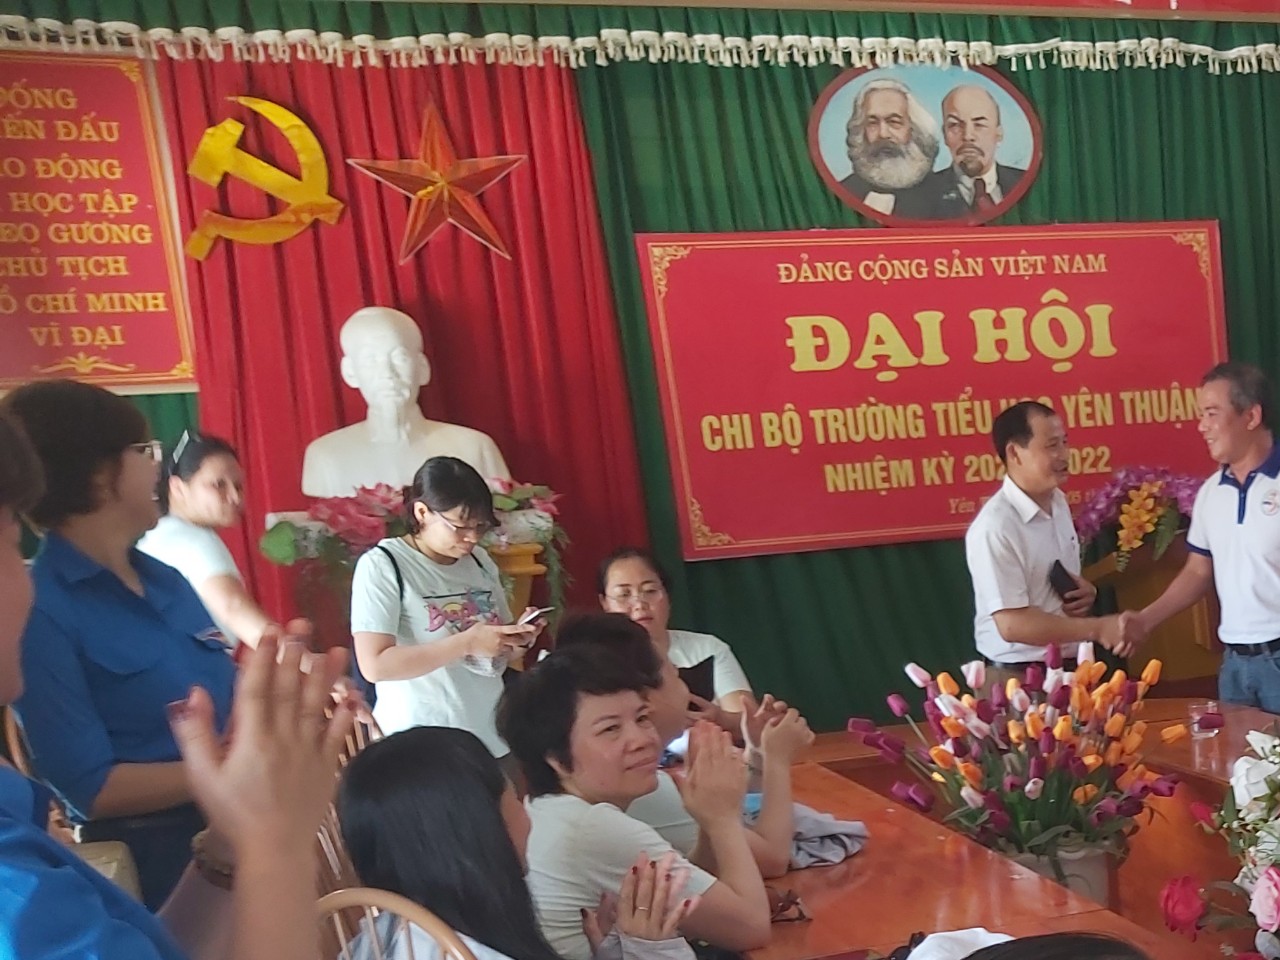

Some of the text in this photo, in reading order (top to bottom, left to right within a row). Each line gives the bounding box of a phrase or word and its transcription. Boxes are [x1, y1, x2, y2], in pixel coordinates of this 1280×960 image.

[55, 111, 120, 142] ĐẤU
[34, 152, 123, 183] ĐỘNG
[9, 188, 138, 218] HỌC TẬP
[48, 221, 153, 244] GƯƠNG
[56, 256, 129, 280] TỊCH
[777, 248, 1108, 285] ĐẢNG CỘNG SẢN VIỆT NAM
[25, 287, 78, 314] CHÍ
[85, 292, 168, 313] MINH
[29, 322, 126, 350] VĨ ĐẠI
[785, 288, 1118, 382] ĐẠI HỘI
[701, 413, 755, 451] CHI
[760, 403, 803, 454] BỘ
[809, 396, 926, 444] TRƯỜNG
[931, 386, 993, 437] TIỂU
[1061, 386, 1114, 429] YÊN
[824, 454, 916, 496] NHIỆM
[922, 450, 955, 486] KỲ
